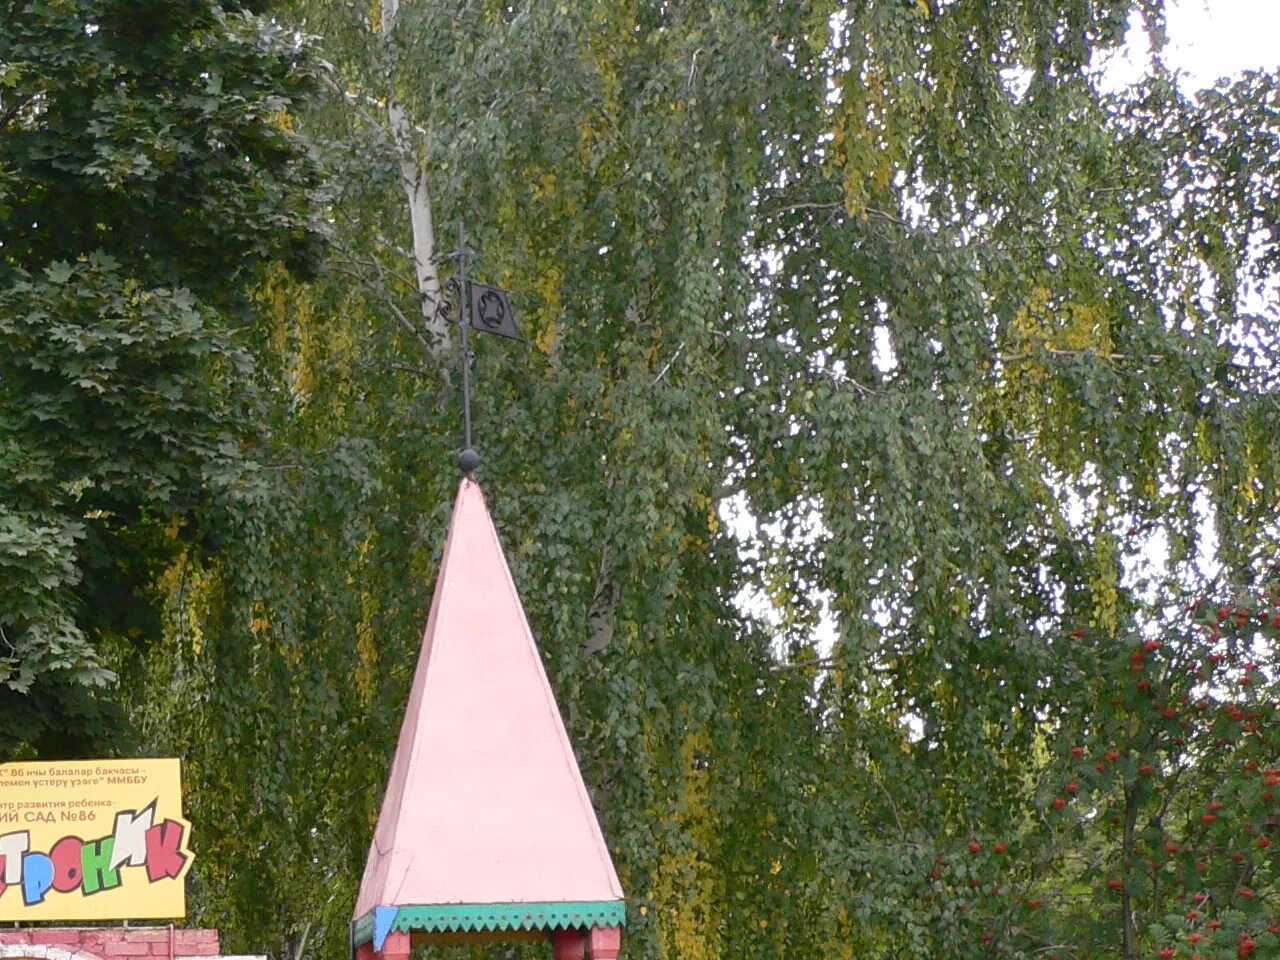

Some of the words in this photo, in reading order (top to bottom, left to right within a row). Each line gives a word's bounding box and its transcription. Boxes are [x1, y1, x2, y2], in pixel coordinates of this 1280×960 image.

[11, 768, 24, 777] 86
[48, 768, 93, 777] балалар
[95, 766, 139, 775] бакчасы
[107, 775, 148, 785] ММББУ
[17, 800, 66, 811] развития
[24, 811, 57, 823] САД
[61, 810, 96, 822] №86
